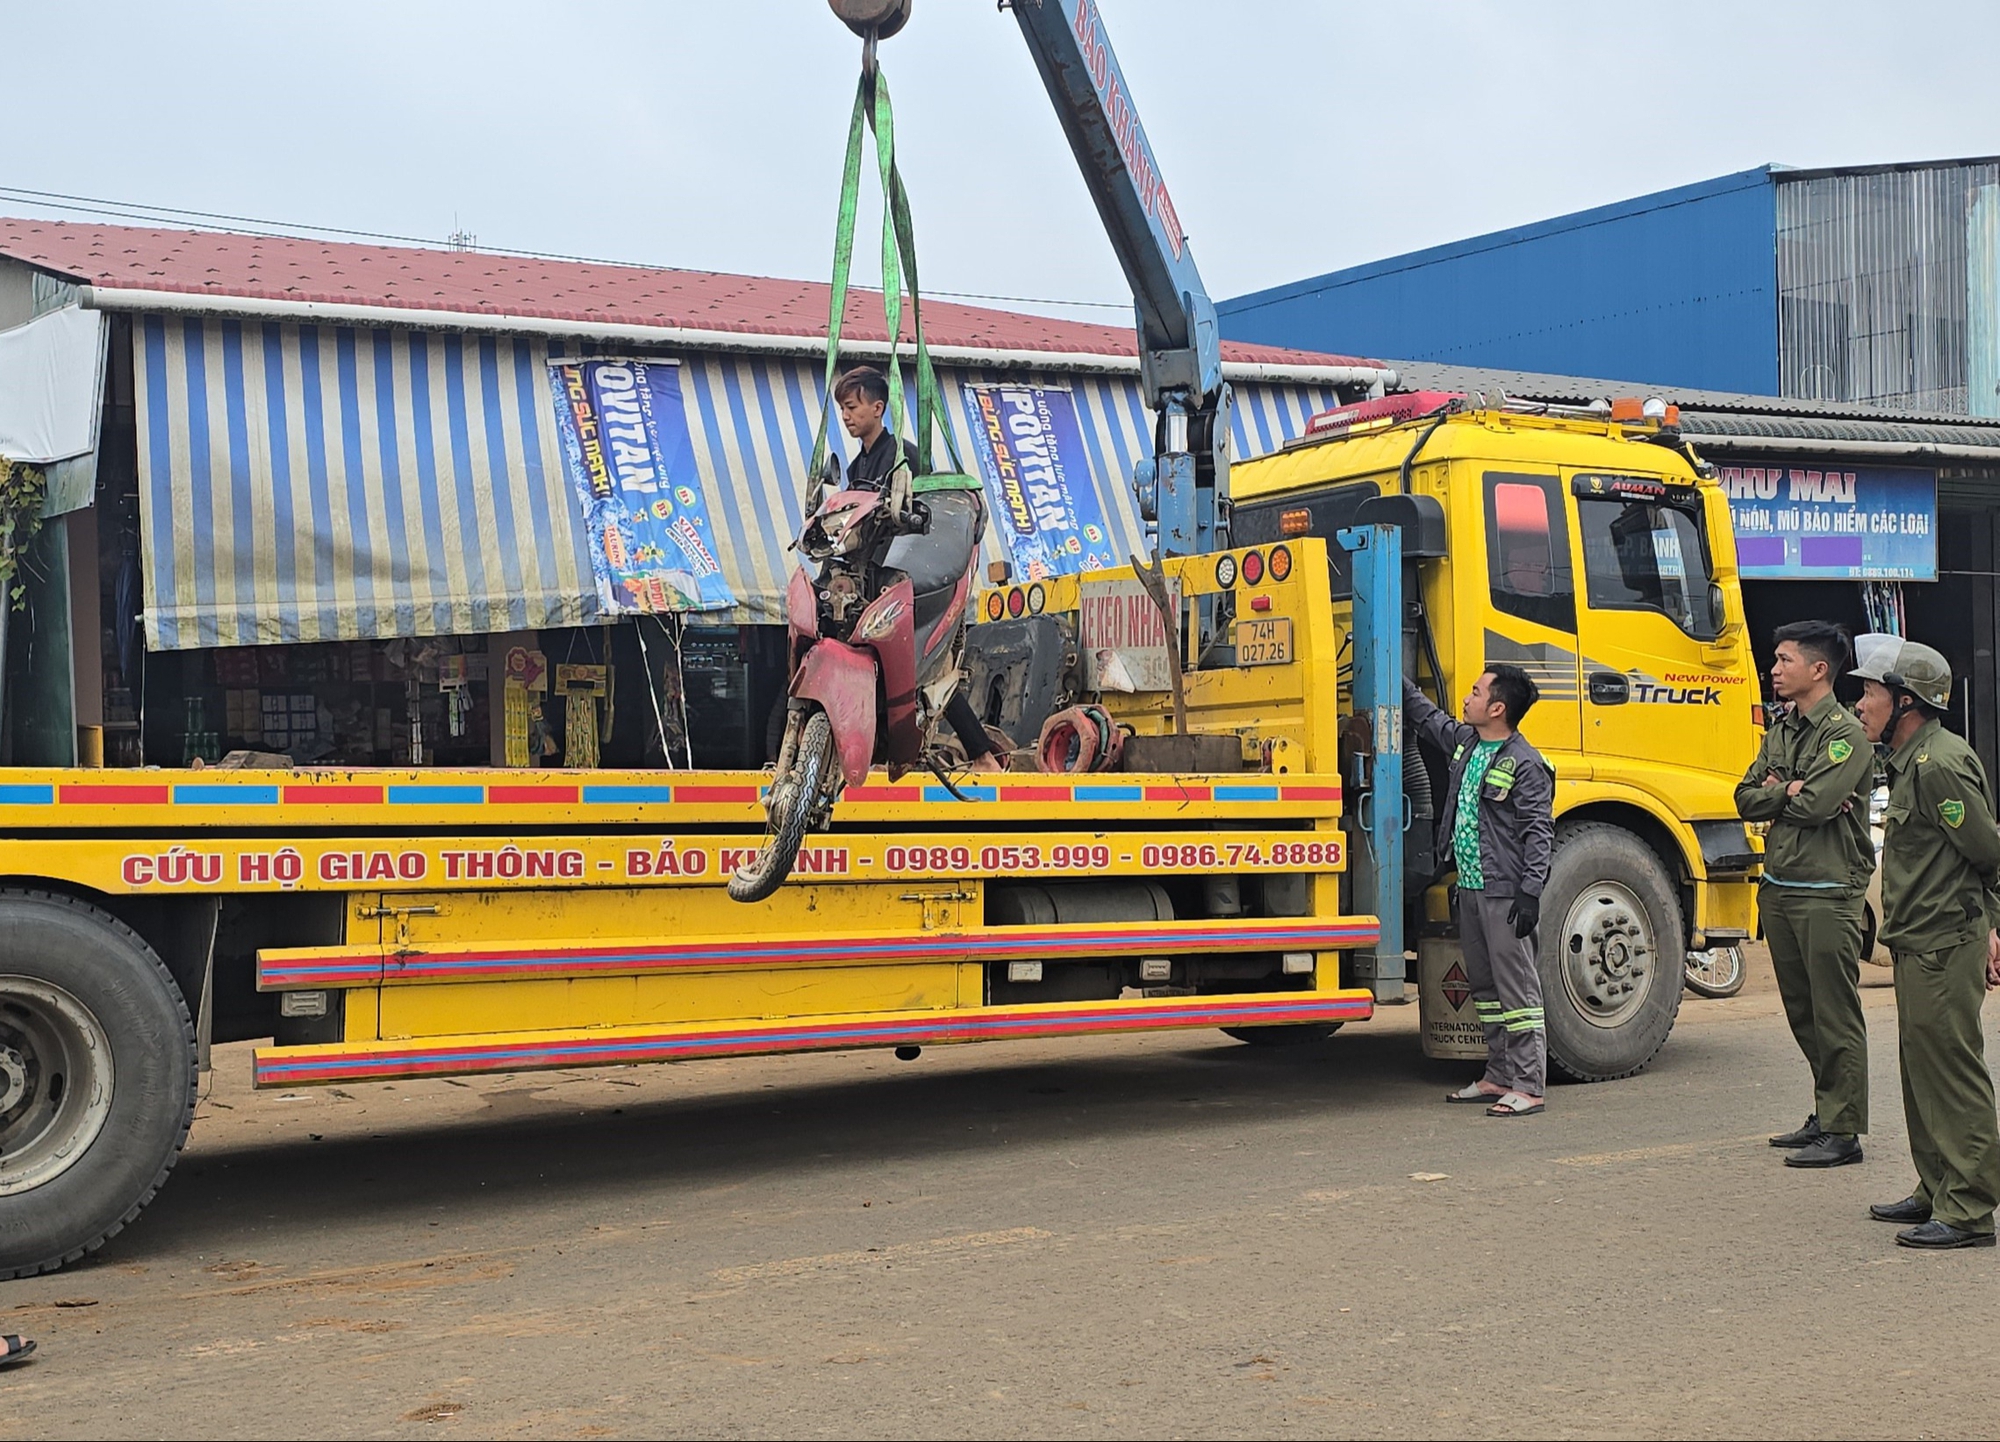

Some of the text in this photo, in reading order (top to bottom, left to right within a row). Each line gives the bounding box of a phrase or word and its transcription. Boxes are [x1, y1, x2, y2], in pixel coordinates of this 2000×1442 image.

[595, 361, 658, 493] OVITAN
[1610, 481, 1666, 495] AUMAN
[1789, 469, 1856, 503] MAI
[1777, 506, 1800, 532] MŨ
[1803, 505, 1832, 532] BẢO
[1833, 504, 1868, 533] HIỂM
[1870, 508, 1898, 534] CÁC
[1900, 513, 1929, 539] LOẠI
[1082, 597, 1094, 649] XE
[1097, 586, 1122, 648] KÉO
[1251, 622, 1275, 641] 74H
[1242, 643, 1285, 662] 027.26
[122, 845, 223, 886] CỨU
[238, 846, 302, 889] HỘ
[318, 850, 428, 882] GIAO
[440, 845, 584, 879] THÔNG
[627, 839, 707, 877] BẢO
[720, 847, 849, 876] KNH
[884, 844, 1110, 872] 0989.053.999
[1141, 842, 1342, 868] 0986.74.8888
[1430, 1021, 1484, 1033] NTERNATION
[1430, 1033, 1488, 1045] TRUCK CENTE
